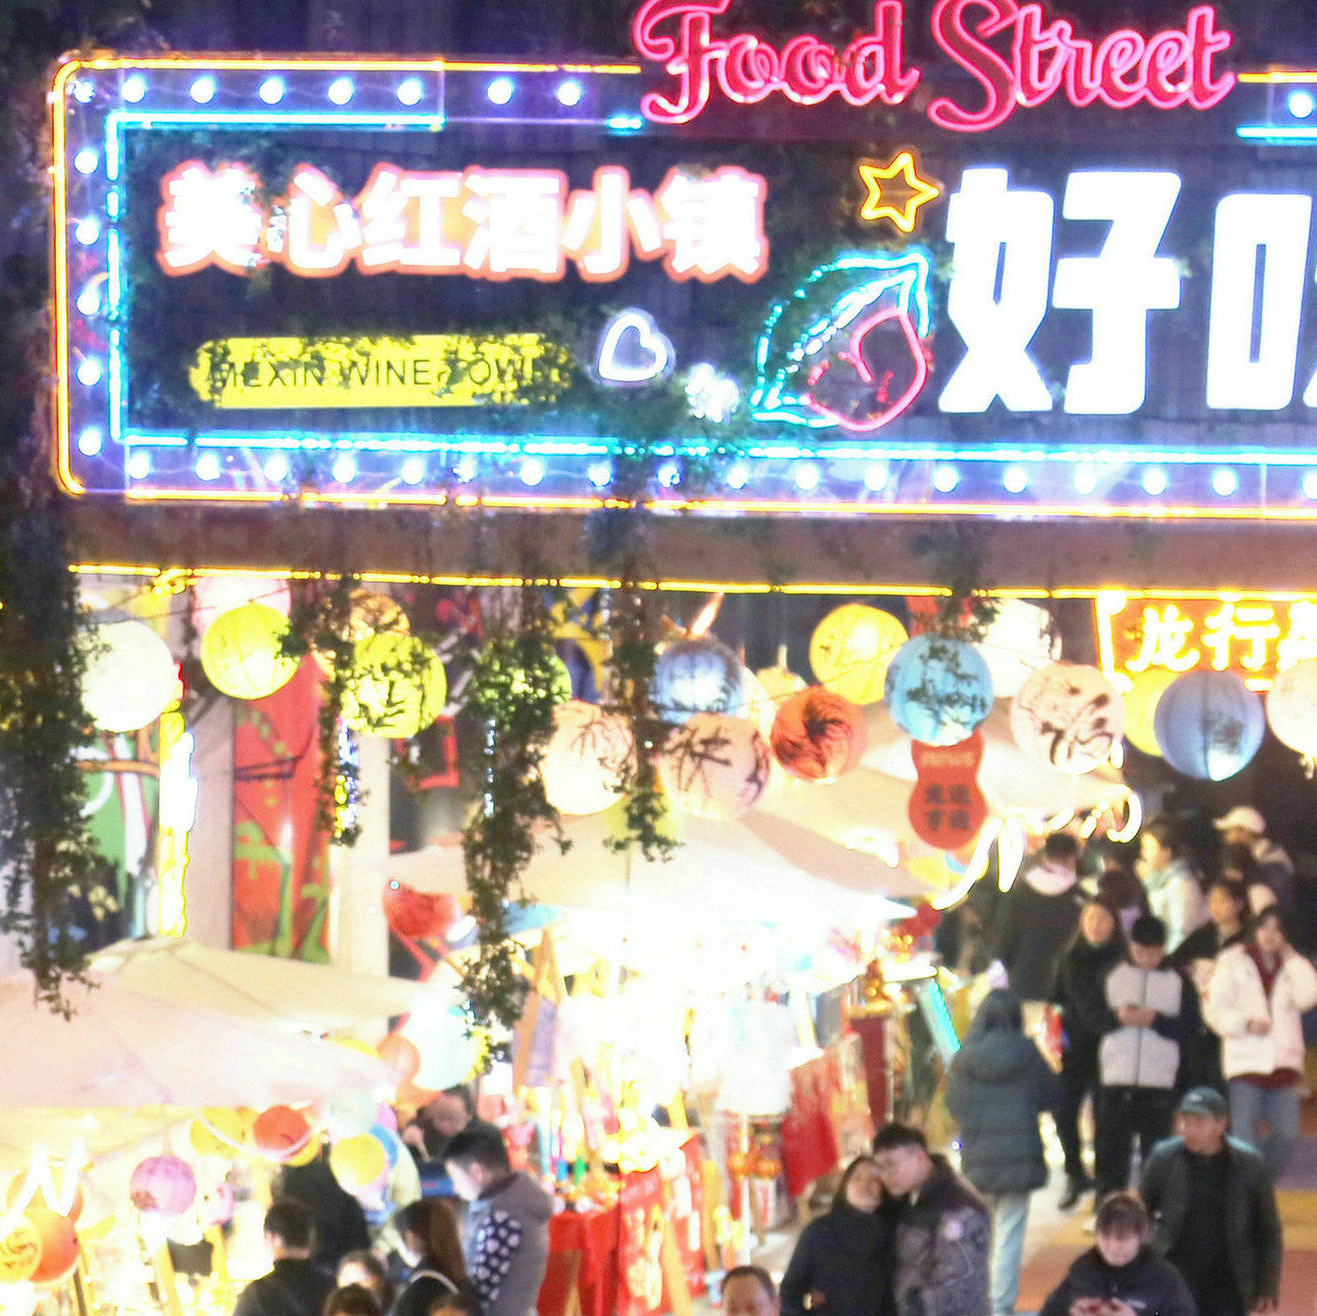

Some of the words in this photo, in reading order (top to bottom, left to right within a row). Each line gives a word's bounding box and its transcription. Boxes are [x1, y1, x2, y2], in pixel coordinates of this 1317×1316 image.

[633, 0, 921, 124] Food
[927, 0, 1236, 131] Street
[161, 161, 767, 279] 美心红酒小镇
[341, 359, 432, 386] WINE
